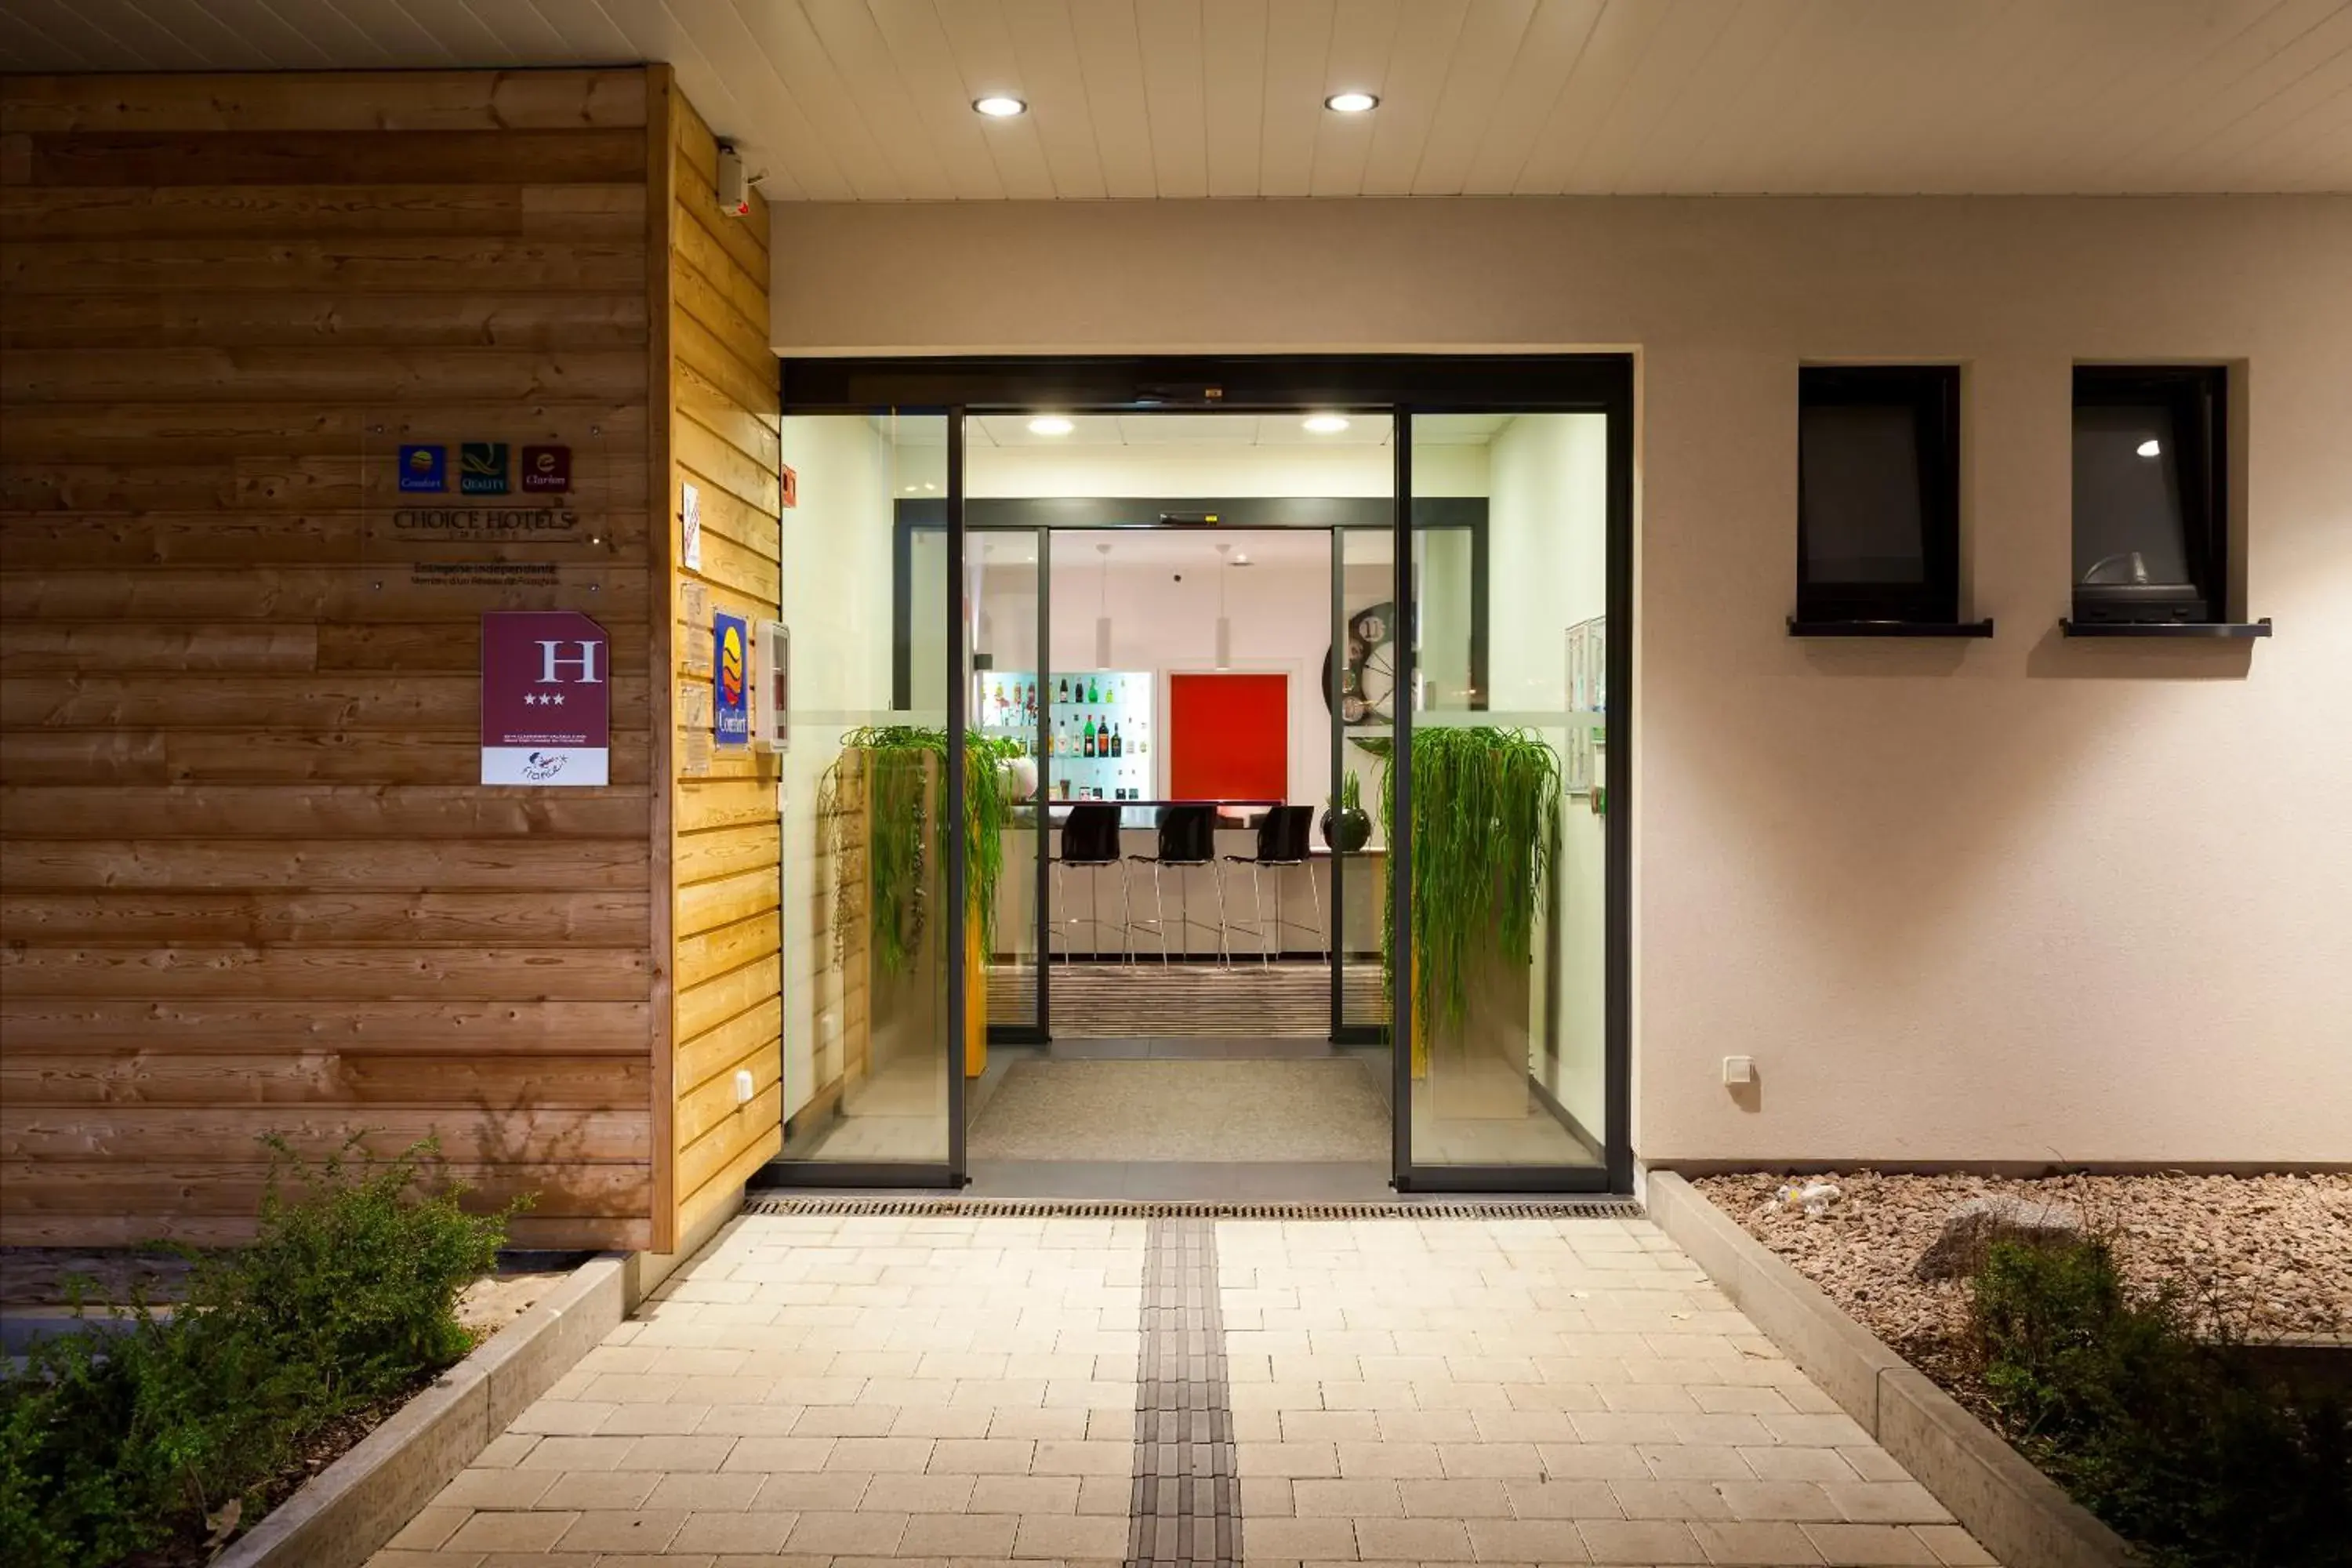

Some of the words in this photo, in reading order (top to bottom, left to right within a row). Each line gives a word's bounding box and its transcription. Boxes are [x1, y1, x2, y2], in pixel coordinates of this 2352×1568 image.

[462, 477, 504, 490] QUALITY
[526, 474, 565, 486] Clarion
[394, 510, 480, 529] CHOICE
[485, 510, 572, 529] HOTELS
[533, 641, 603, 683] H
[718, 708, 746, 734] Comfort
